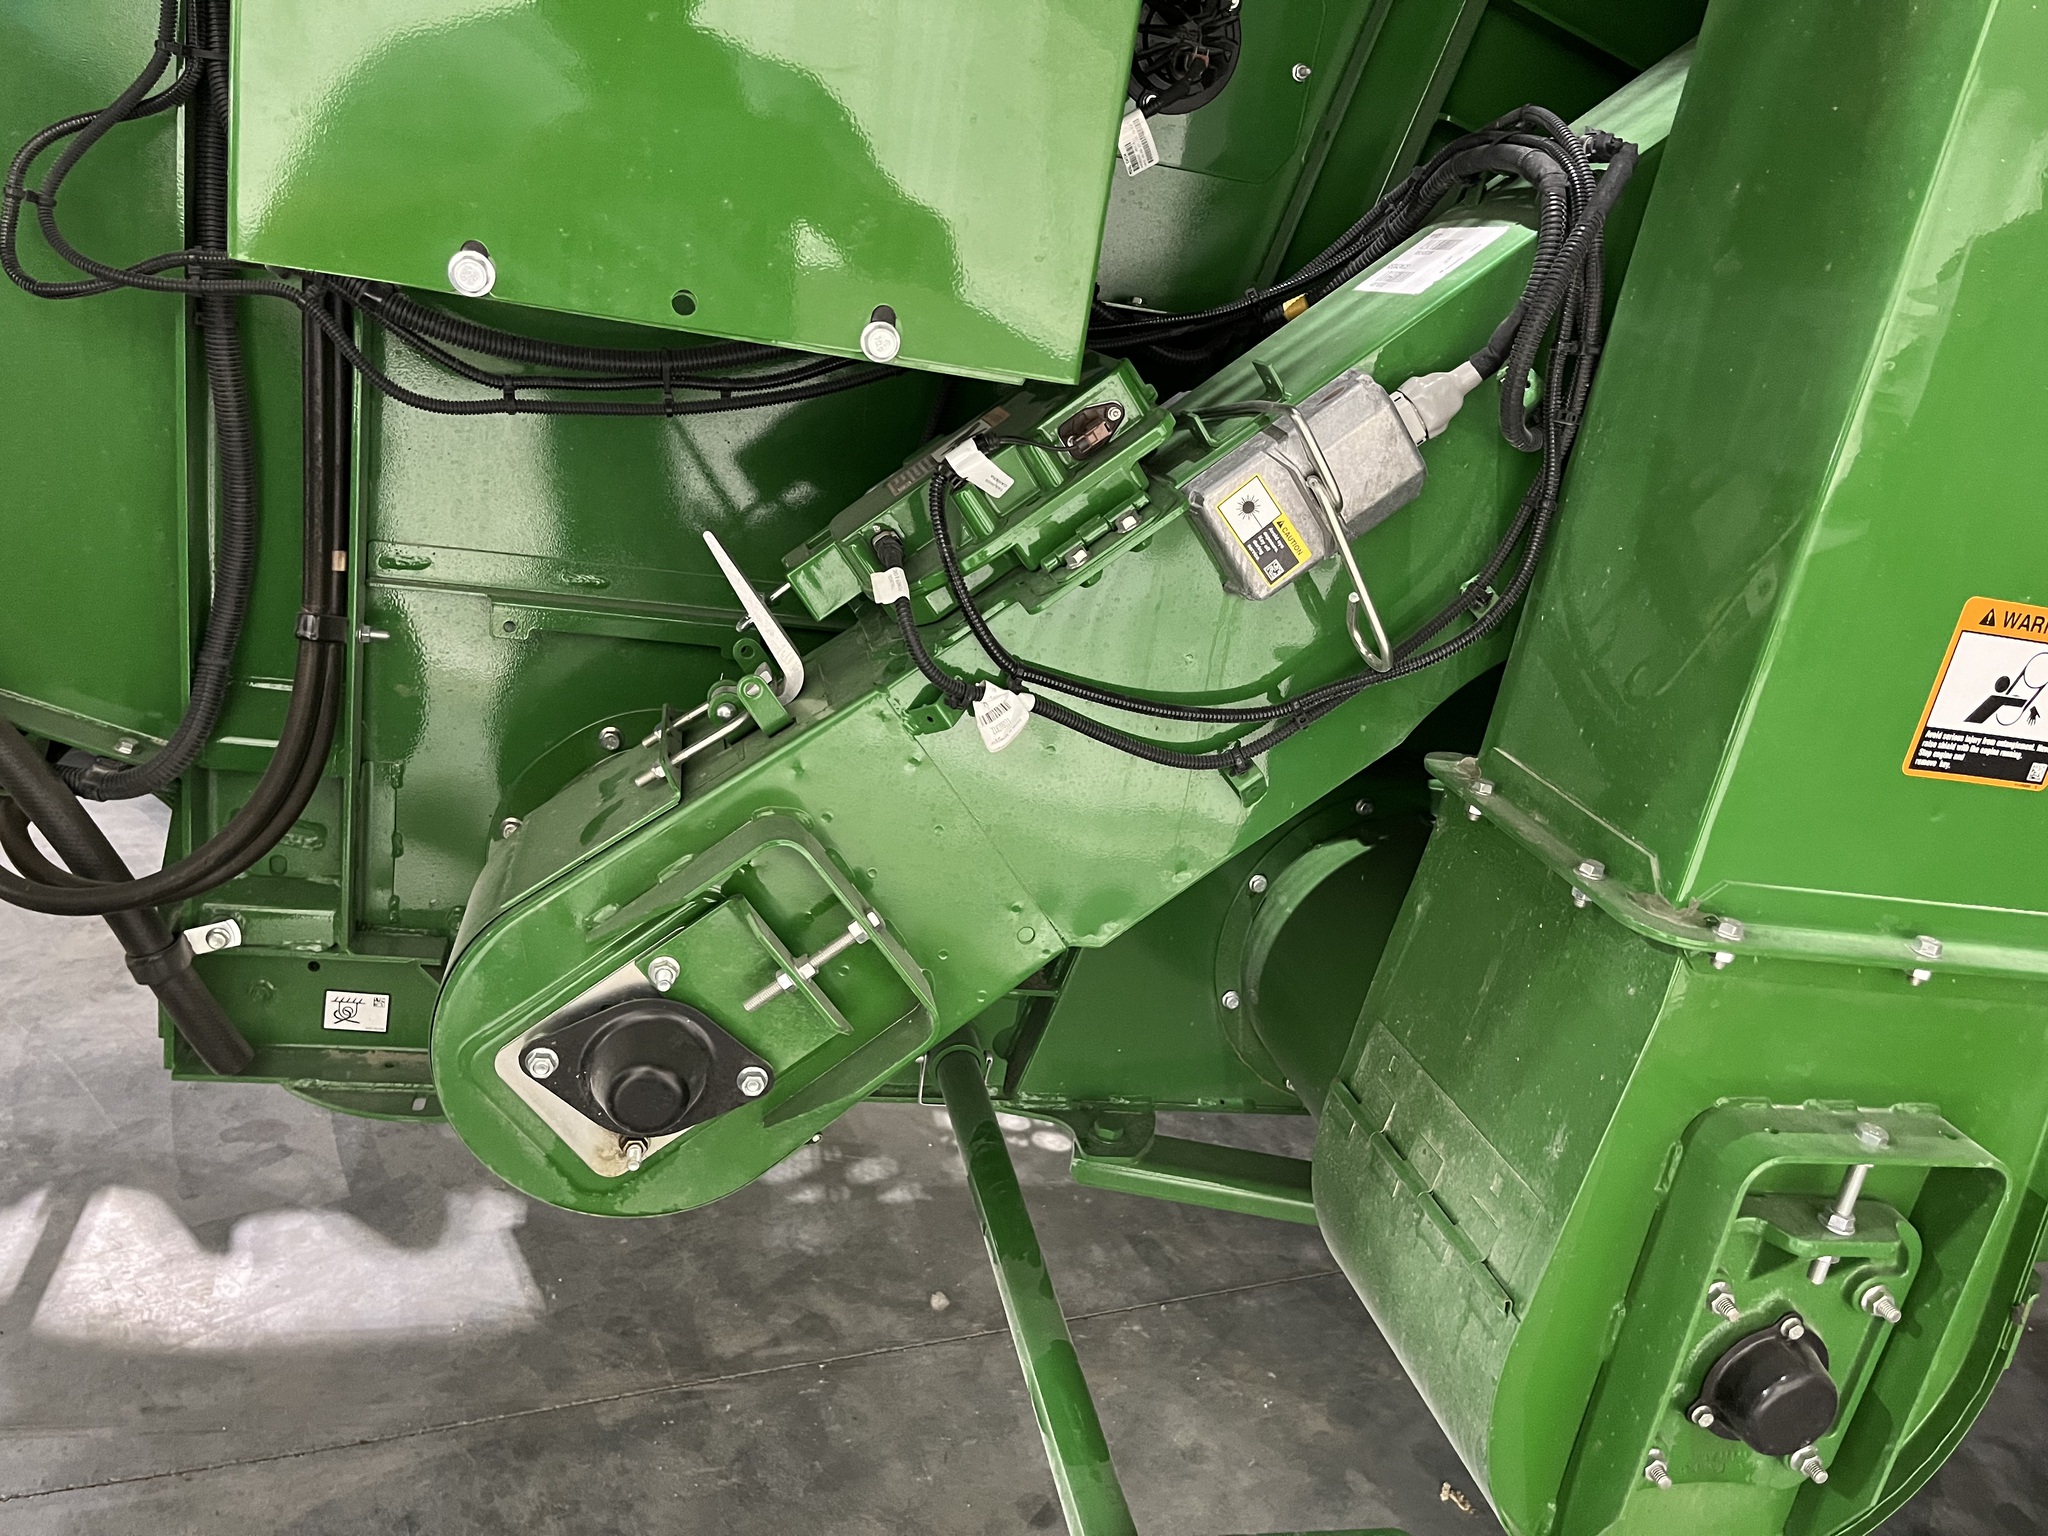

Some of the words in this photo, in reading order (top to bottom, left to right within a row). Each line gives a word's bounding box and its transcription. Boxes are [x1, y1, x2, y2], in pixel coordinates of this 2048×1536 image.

[1268, 527, 1280, 541] Avoid
[1282, 527, 1303, 556] CAUTION
[2004, 610, 2048, 634] WAR
[1925, 730, 1943, 740] Avoid
[1942, 733, 1965, 743] serious
[1965, 735, 1982, 746] injury
[1982, 737, 1996, 746] from
[1918, 748, 1933, 758] Stop
[1932, 751, 1953, 761] engine
[1953, 753, 1966, 761] and
[1921, 740, 1937, 749] raise
[1937, 742, 1957, 751] shield
[1956, 743, 1970, 752] with
[1969, 744, 1980, 754] the
[1980, 747, 2000, 757] engine
[1914, 758, 1938, 767] remove
